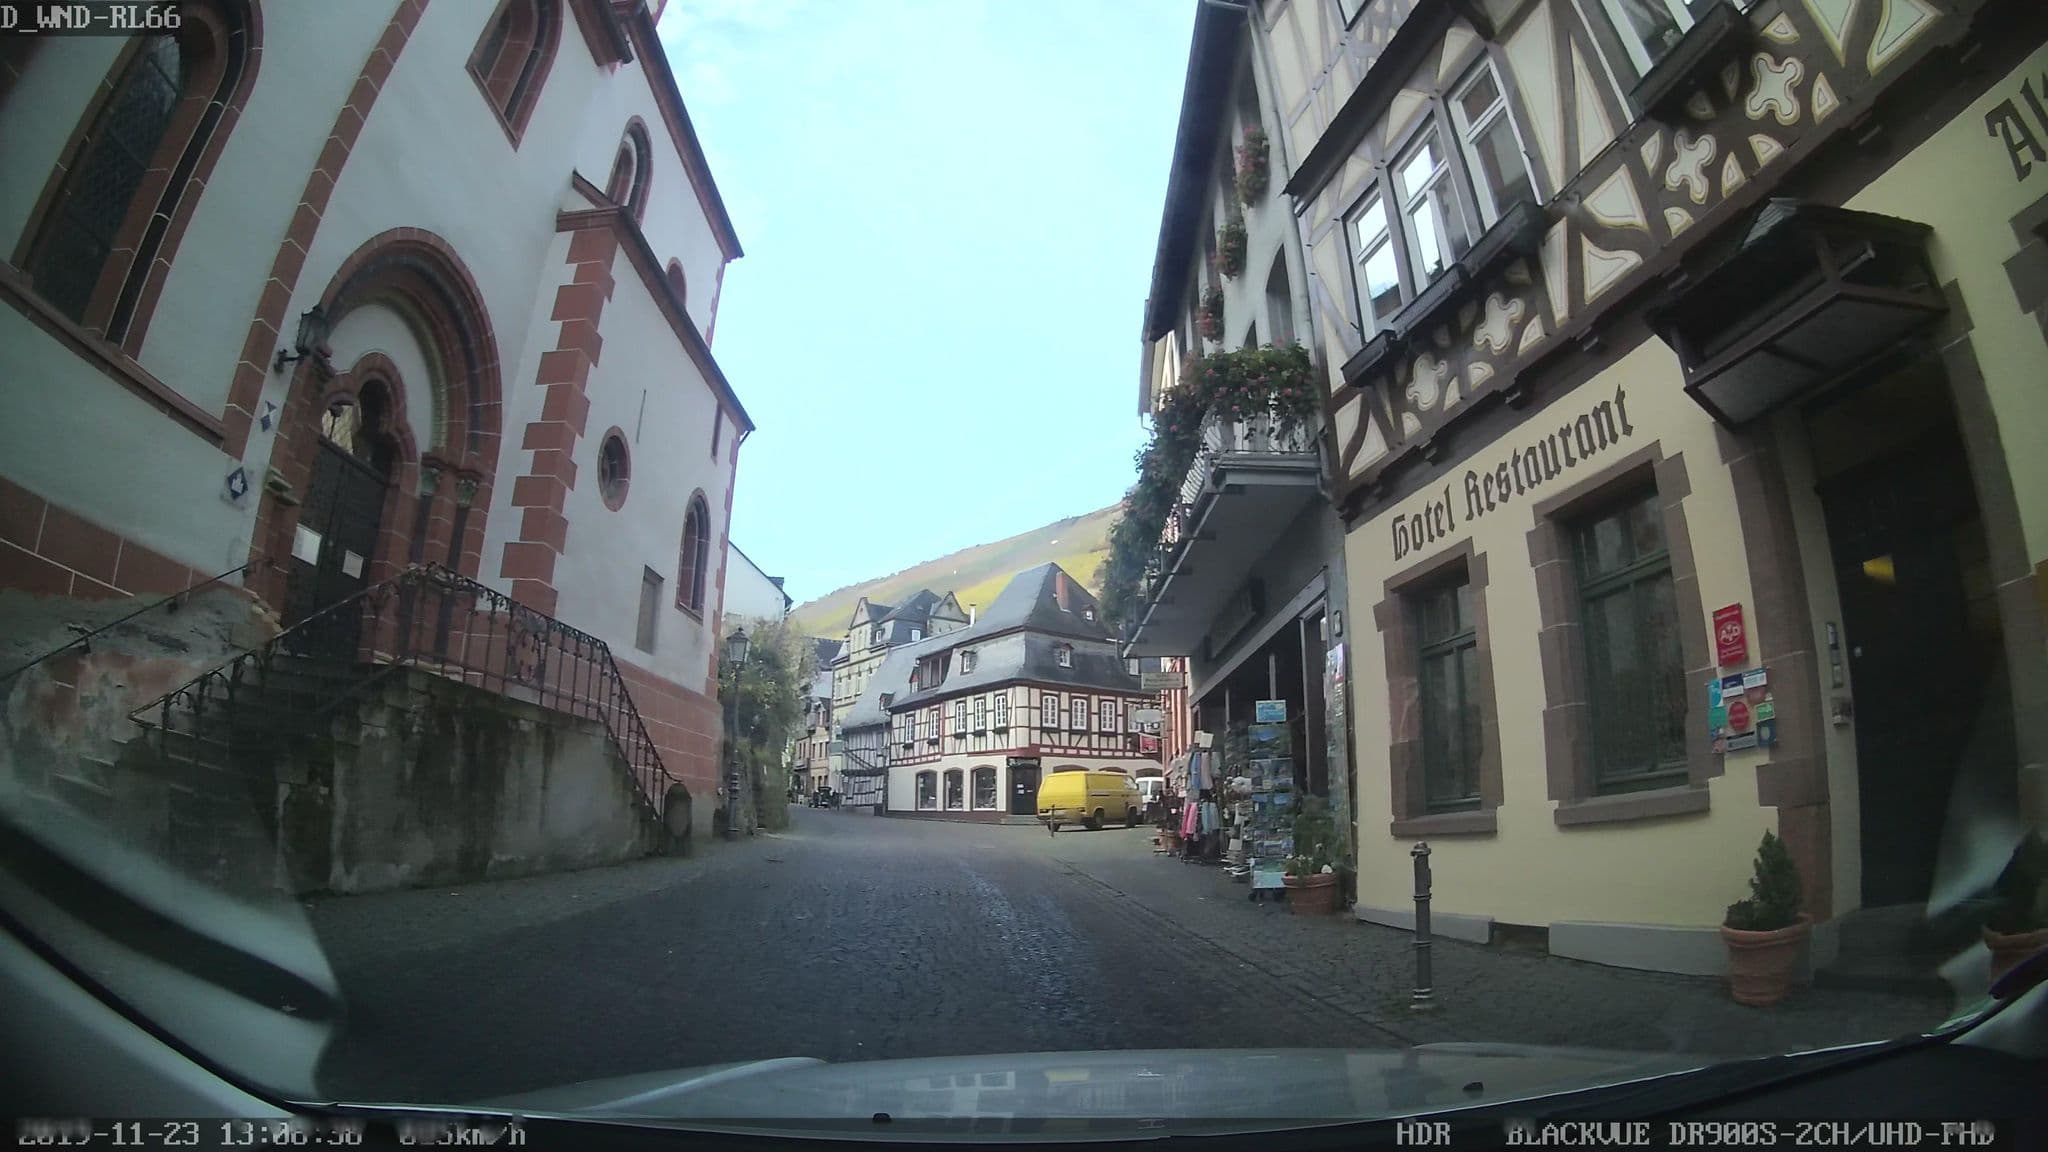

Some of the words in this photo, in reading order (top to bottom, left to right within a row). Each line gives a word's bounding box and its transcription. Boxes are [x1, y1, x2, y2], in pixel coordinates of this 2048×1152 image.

[1985, 72, 2048, 182] Al
[1391, 483, 1455, 561] Hotel
[1464, 384, 1634, 521] Restaurant
